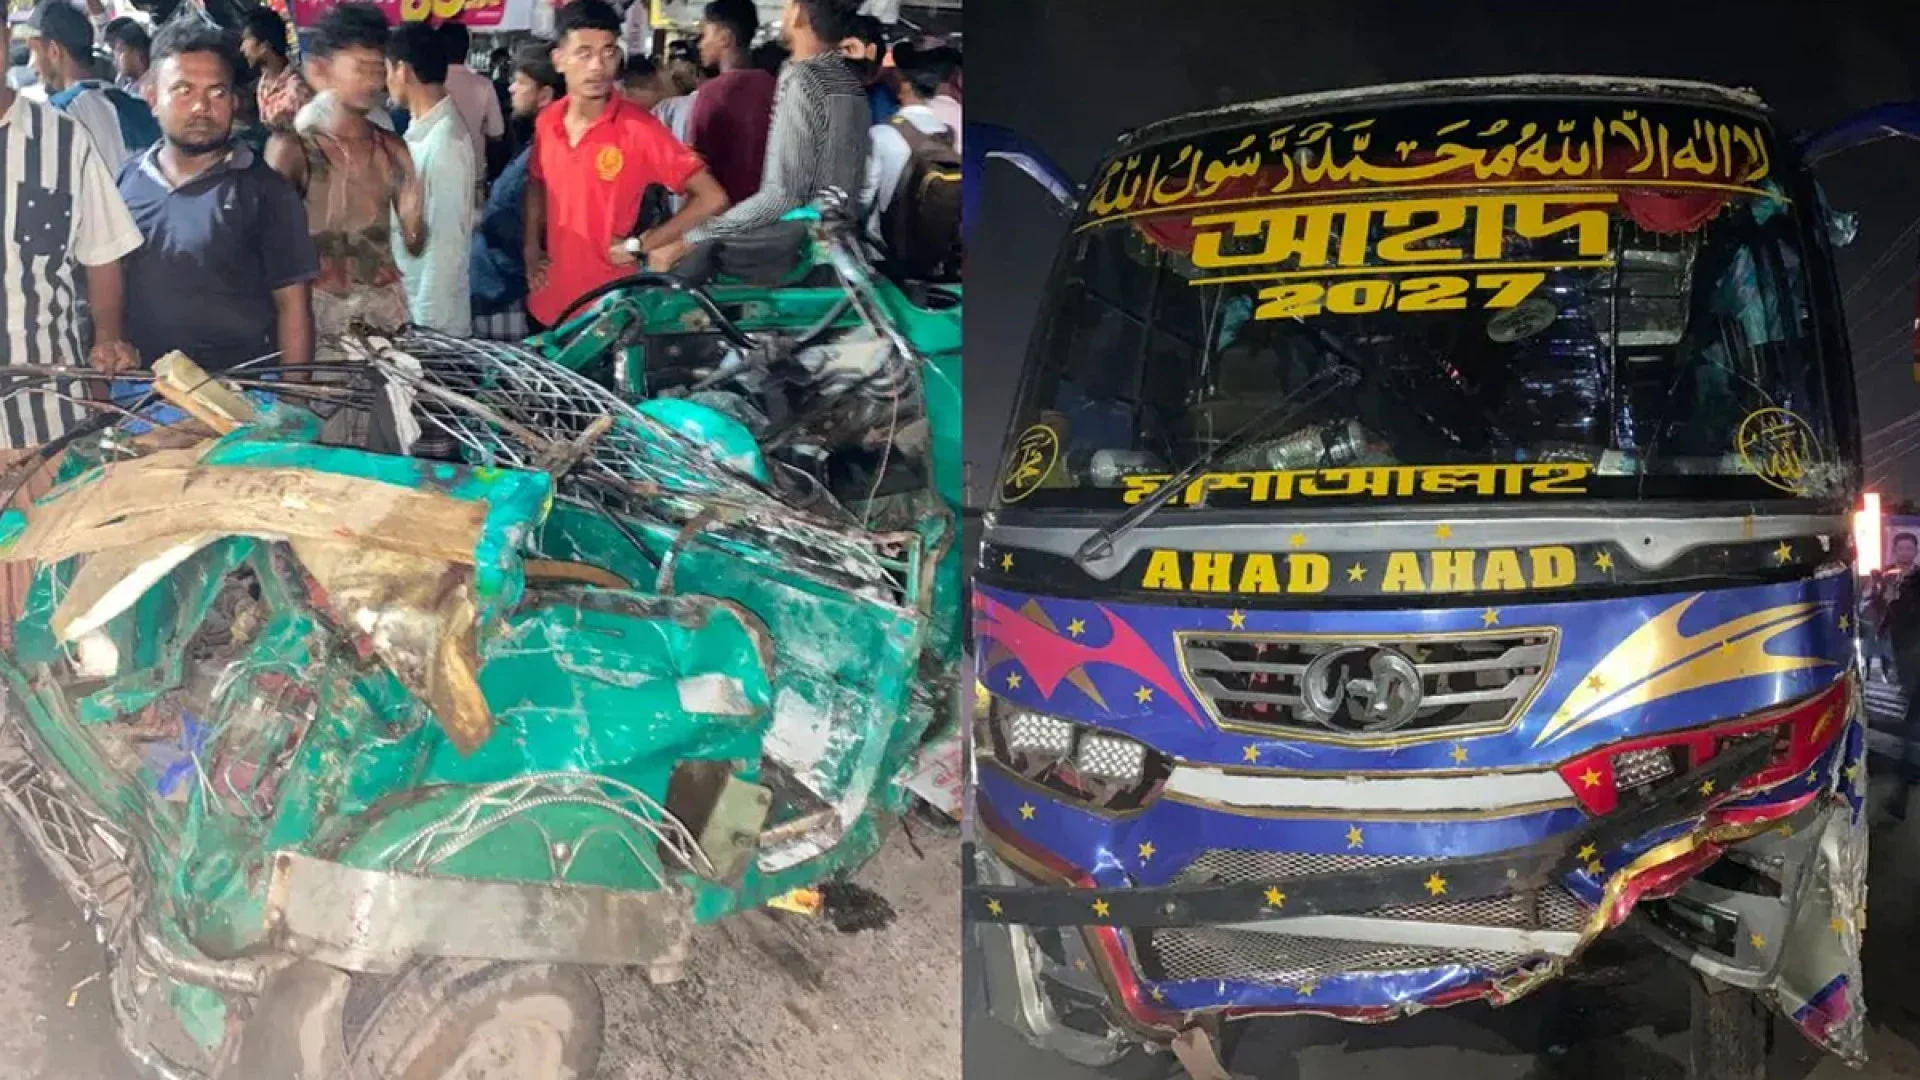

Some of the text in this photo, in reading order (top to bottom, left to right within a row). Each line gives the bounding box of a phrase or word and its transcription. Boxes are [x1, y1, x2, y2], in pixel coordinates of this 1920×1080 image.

[1191, 193, 1619, 268] আহাদ
[1254, 273, 1545, 321] 2027
[1141, 546, 1577, 593] AHAD AHAD
